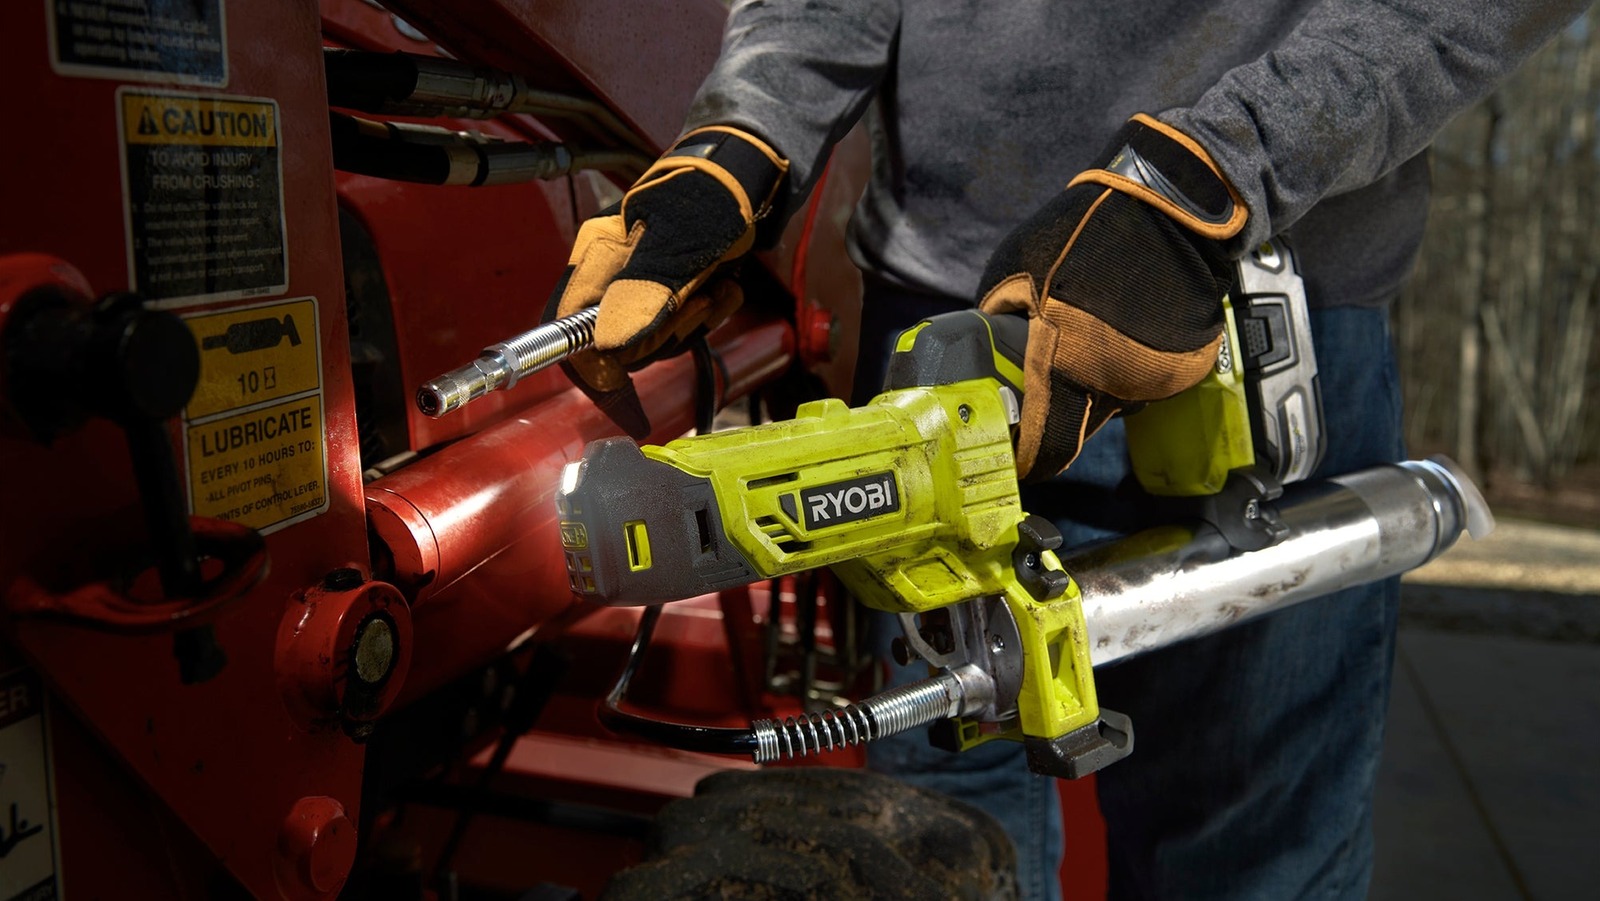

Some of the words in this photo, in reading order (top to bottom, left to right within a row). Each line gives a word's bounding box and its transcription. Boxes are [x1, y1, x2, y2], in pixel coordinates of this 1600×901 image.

[163, 108, 267, 137] CAUTION
[152, 151, 170, 166] TO
[171, 151, 210, 167] AVOID
[212, 152, 252, 167] INJURY
[152, 174, 192, 190] FROM
[193, 174, 254, 190] CRUSHING
[238, 371, 259, 395] 10
[201, 406, 312, 457] LUBRICATE
[201, 462, 239, 485] EVERY
[243, 457, 256, 470] 10
[258, 444, 295, 466] HOURS
[298, 440, 316, 454] TO:
[227, 480, 252, 497] PIVOT
[807, 479, 893, 522] RYOBI
[242, 502, 254, 515] OF
[255, 490, 294, 511] CONTROL
